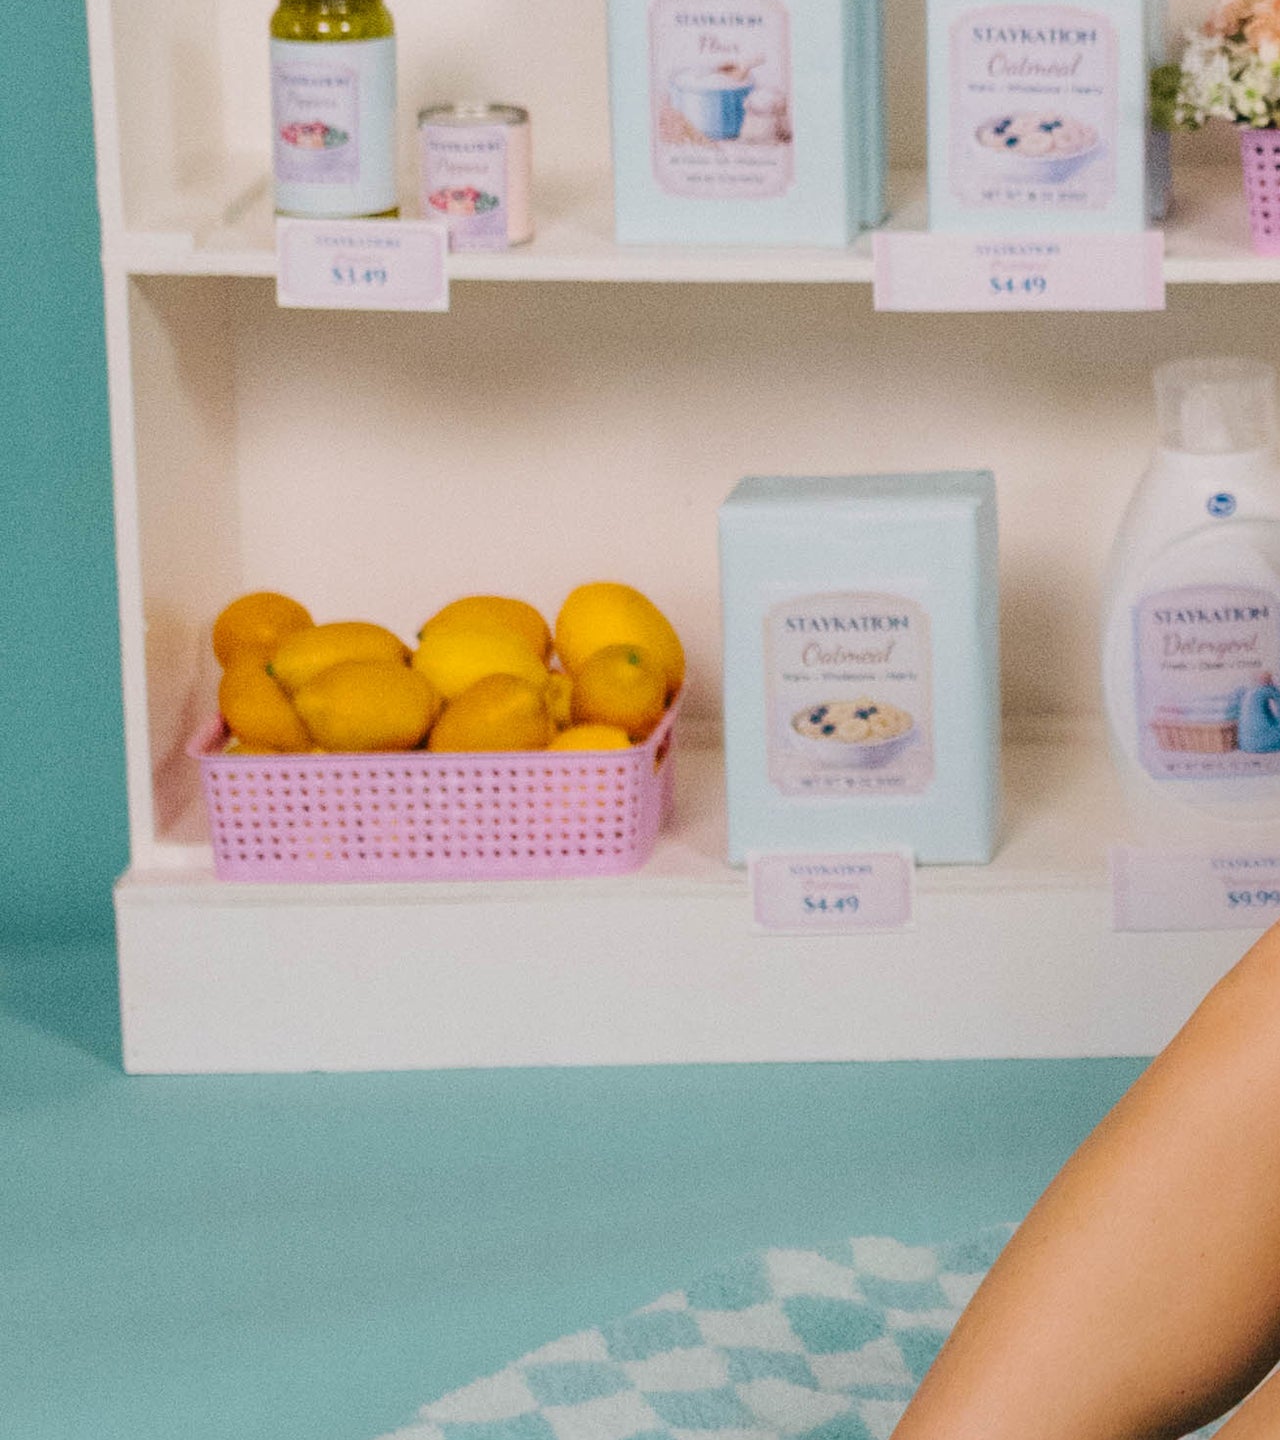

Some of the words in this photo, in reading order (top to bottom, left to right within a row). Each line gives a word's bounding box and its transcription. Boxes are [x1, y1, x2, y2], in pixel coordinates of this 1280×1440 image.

[675, 13, 764, 26] STAYKATION
[698, 34, 740, 54] Flour
[972, 27, 1098, 43] STAYKATION
[986, 51, 1083, 78] Oatmeal
[989, 276, 1048, 295] $4.49
[785, 616, 910, 632] STAYKATION
[1153, 605, 1270, 625] STAYKATION
[800, 638, 896, 668] Oatmeal
[1161, 632, 1260, 660] Detergent
[803, 894, 860, 914] $4.49
